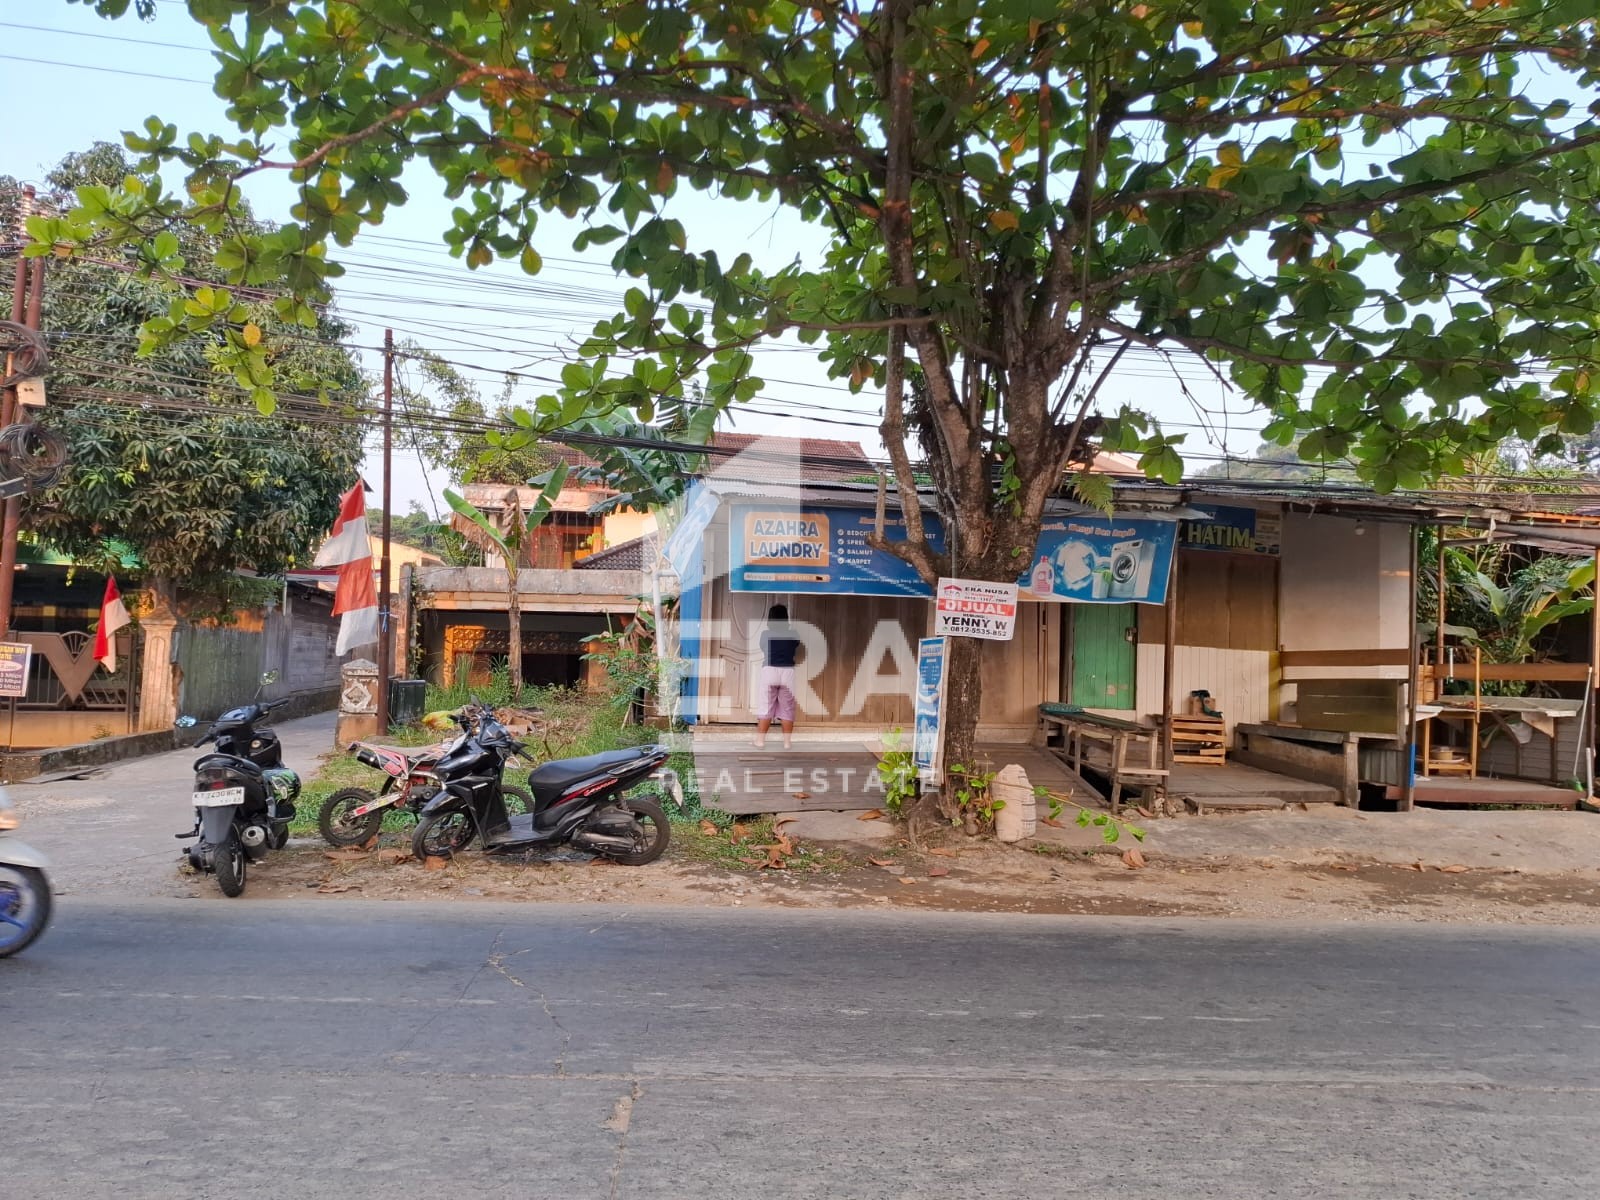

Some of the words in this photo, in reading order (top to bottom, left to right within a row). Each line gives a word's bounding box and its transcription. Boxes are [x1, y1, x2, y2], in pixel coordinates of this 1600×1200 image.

[753, 519, 819, 537] AZAHRA
[1187, 522, 1250, 548] HATIM
[750, 541, 823, 558] LAUNDRY
[944, 600, 1006, 616] DIJUAL
[943, 616, 991, 628] YENNY
[995, 620, 1008, 630] W
